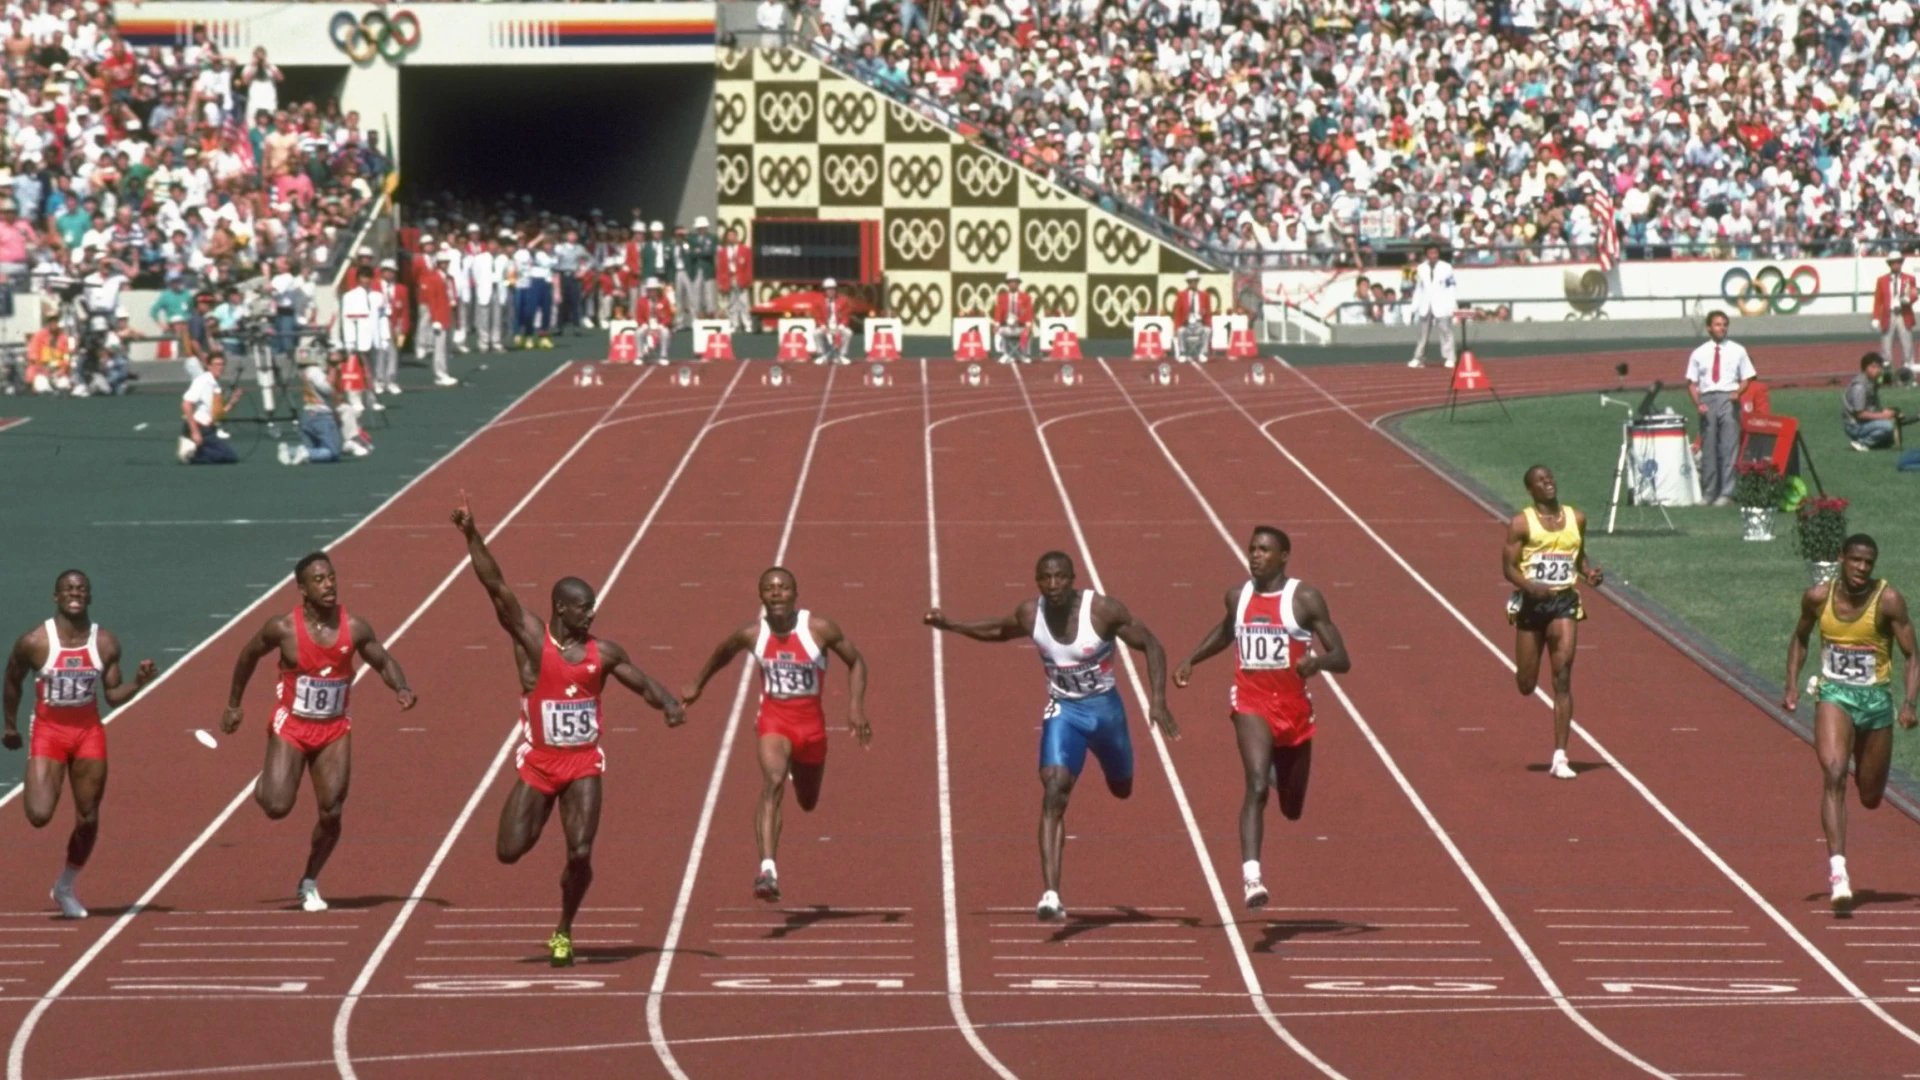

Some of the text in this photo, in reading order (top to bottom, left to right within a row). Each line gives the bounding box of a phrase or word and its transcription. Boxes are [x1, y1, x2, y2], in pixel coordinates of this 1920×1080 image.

[1830, 653, 1867, 678] 125
[303, 687, 341, 710] 181
[552, 710, 590, 737] 159
